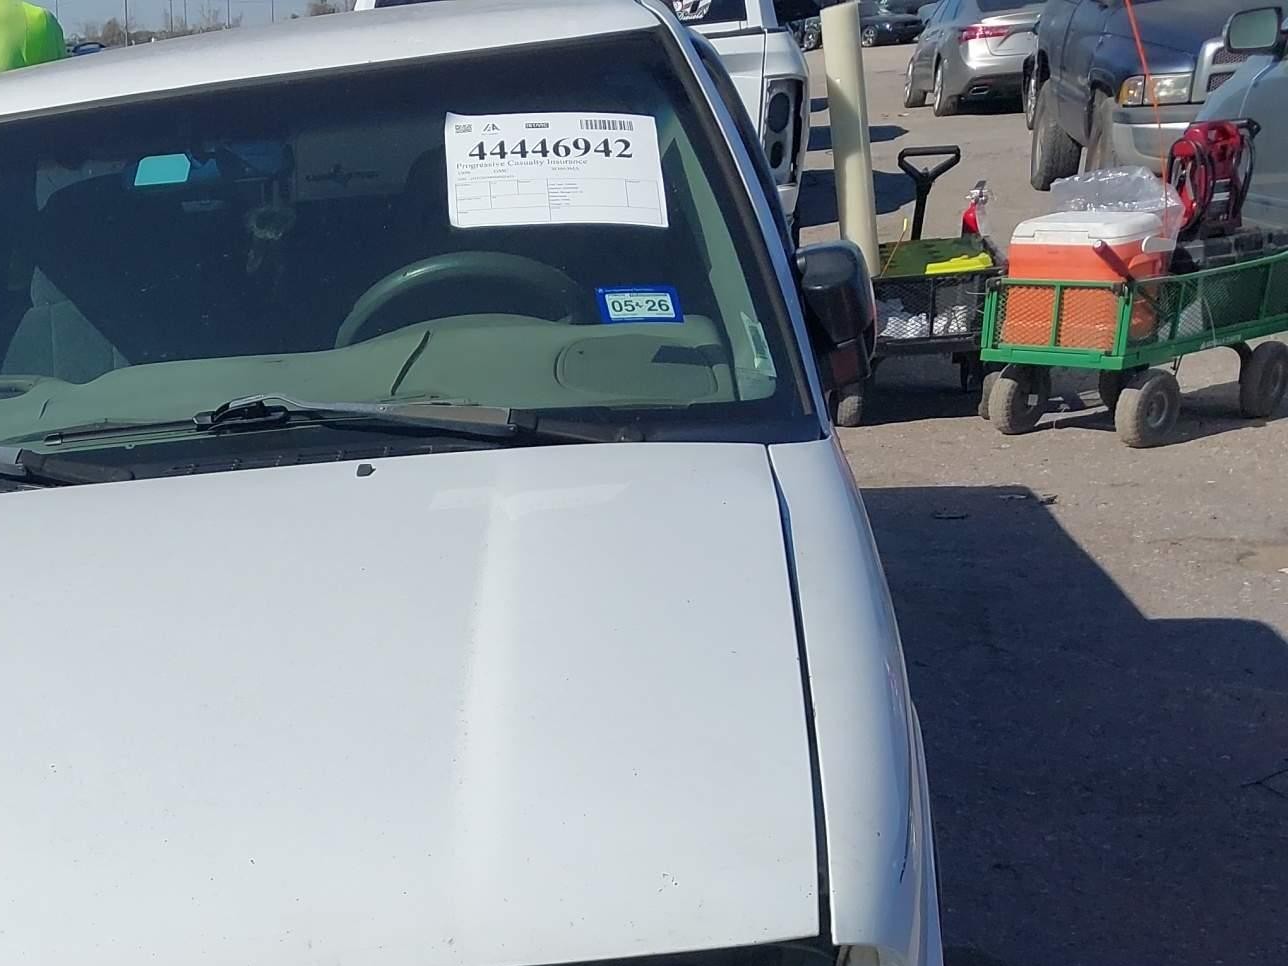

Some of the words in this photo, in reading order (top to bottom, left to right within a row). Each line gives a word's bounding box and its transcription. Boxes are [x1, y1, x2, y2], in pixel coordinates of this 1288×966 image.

[469, 138, 632, 160] 44446942
[456, 161, 505, 170] Progressive
[507, 159, 544, 168] Casualty
[611, 300, 636, 313] 05
[645, 299, 670, 312] 26
